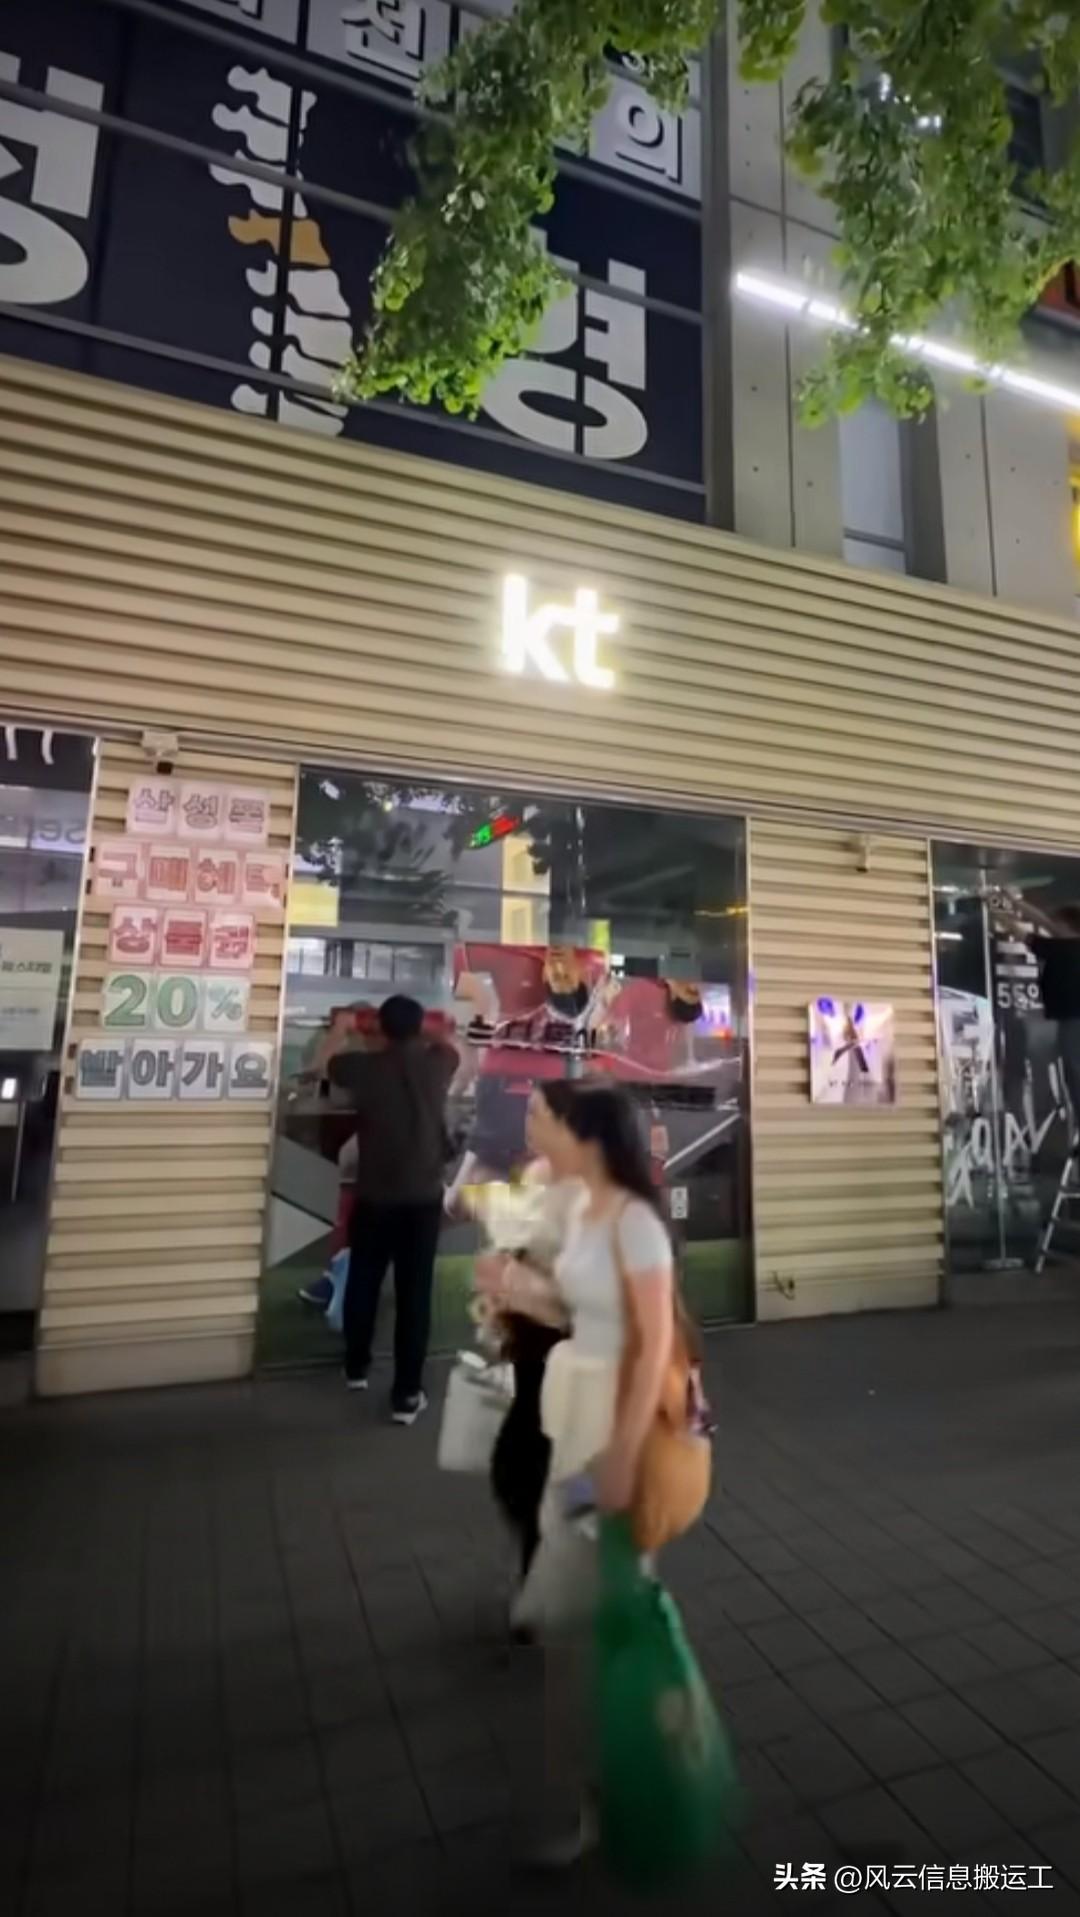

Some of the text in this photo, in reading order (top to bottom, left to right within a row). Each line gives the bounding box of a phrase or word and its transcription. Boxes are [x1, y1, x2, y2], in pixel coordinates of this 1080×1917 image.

[501, 573, 621, 689] kt
[104, 974, 243, 1028] 20%
[78, 1049, 270, 1089] 받아가요
